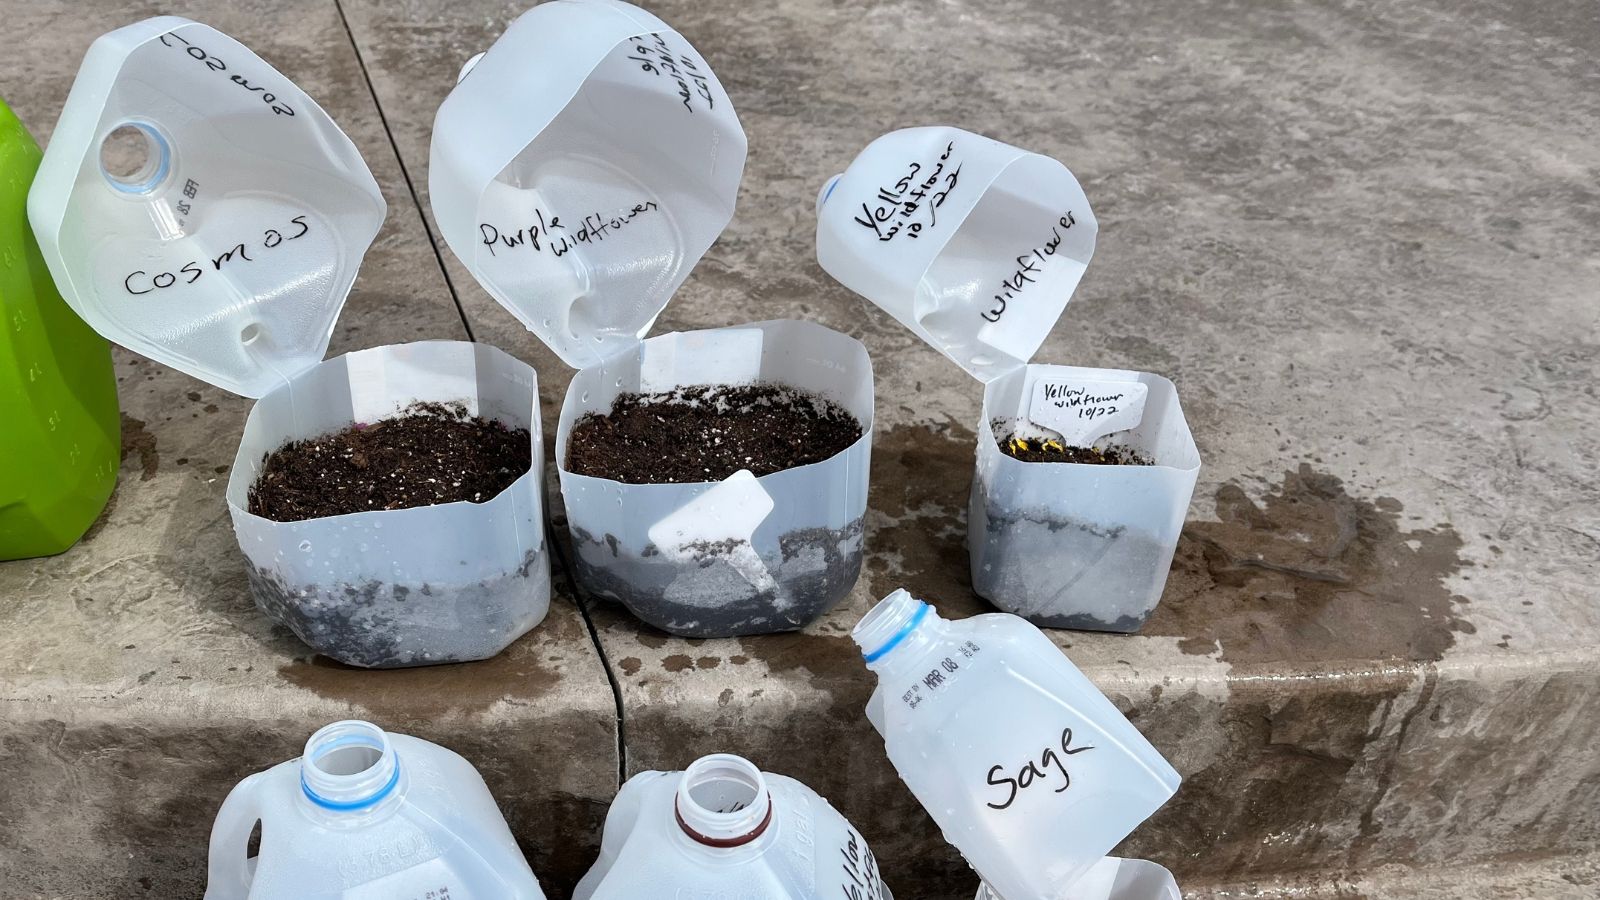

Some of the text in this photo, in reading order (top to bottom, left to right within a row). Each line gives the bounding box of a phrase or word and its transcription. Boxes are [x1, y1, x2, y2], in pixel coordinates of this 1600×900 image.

[854, 162, 921, 237] Yellow
[480, 208, 565, 256] Purple
[1045, 384, 1085, 400] Yellow
[1079, 406, 1119, 420] 10/22
[922, 657, 959, 691] MAR 08
[986, 727, 1095, 810] Sage
